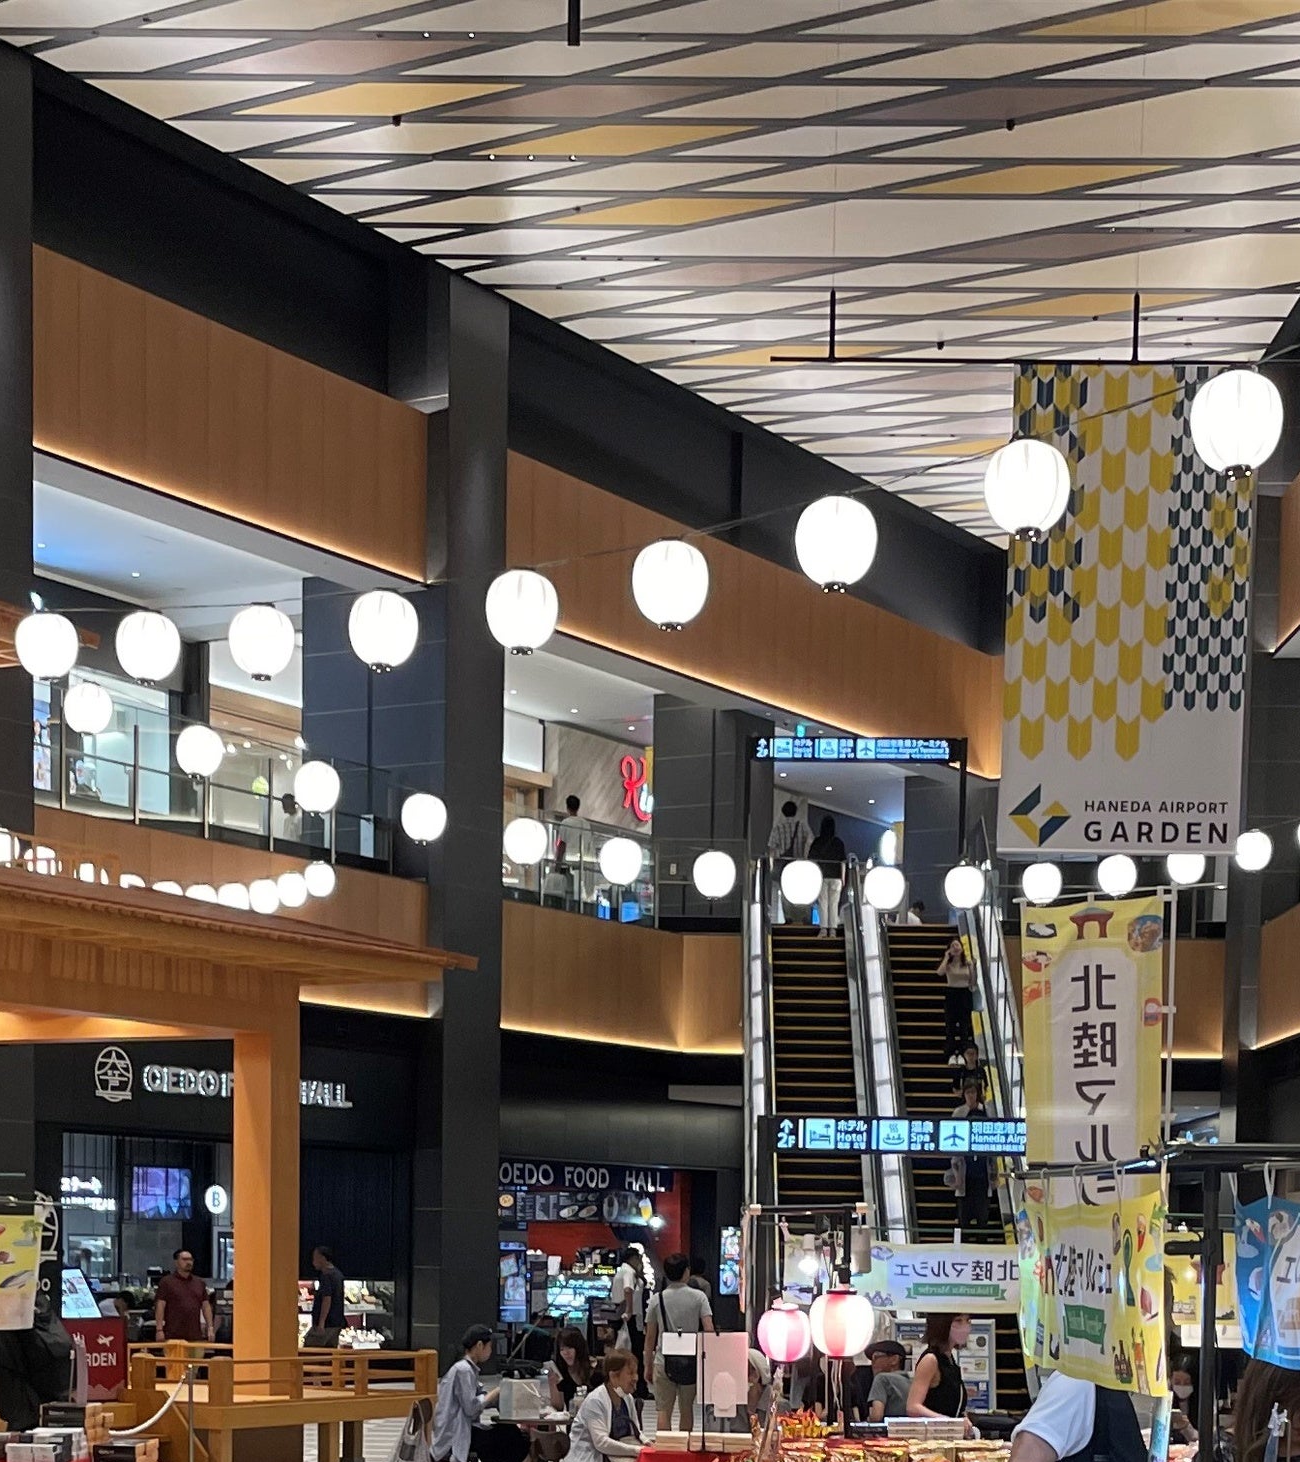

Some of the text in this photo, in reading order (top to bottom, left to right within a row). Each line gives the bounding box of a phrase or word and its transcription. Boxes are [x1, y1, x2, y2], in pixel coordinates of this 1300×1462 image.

[1085, 800, 1229, 816] HANEDA AIRPORT
[1085, 822, 1229, 844] GARDEN
[142, 1064, 221, 1098] OEDO
[837, 1120, 868, 1131] ホテル
[778, 1133, 796, 1148] 2F
[837, 1132, 867, 1142] Hotel
[911, 1133, 931, 1144] Spa
[971, 1134, 1006, 1143] Haneda
[499, 1162, 666, 1192] OEDO FOOD HALL
